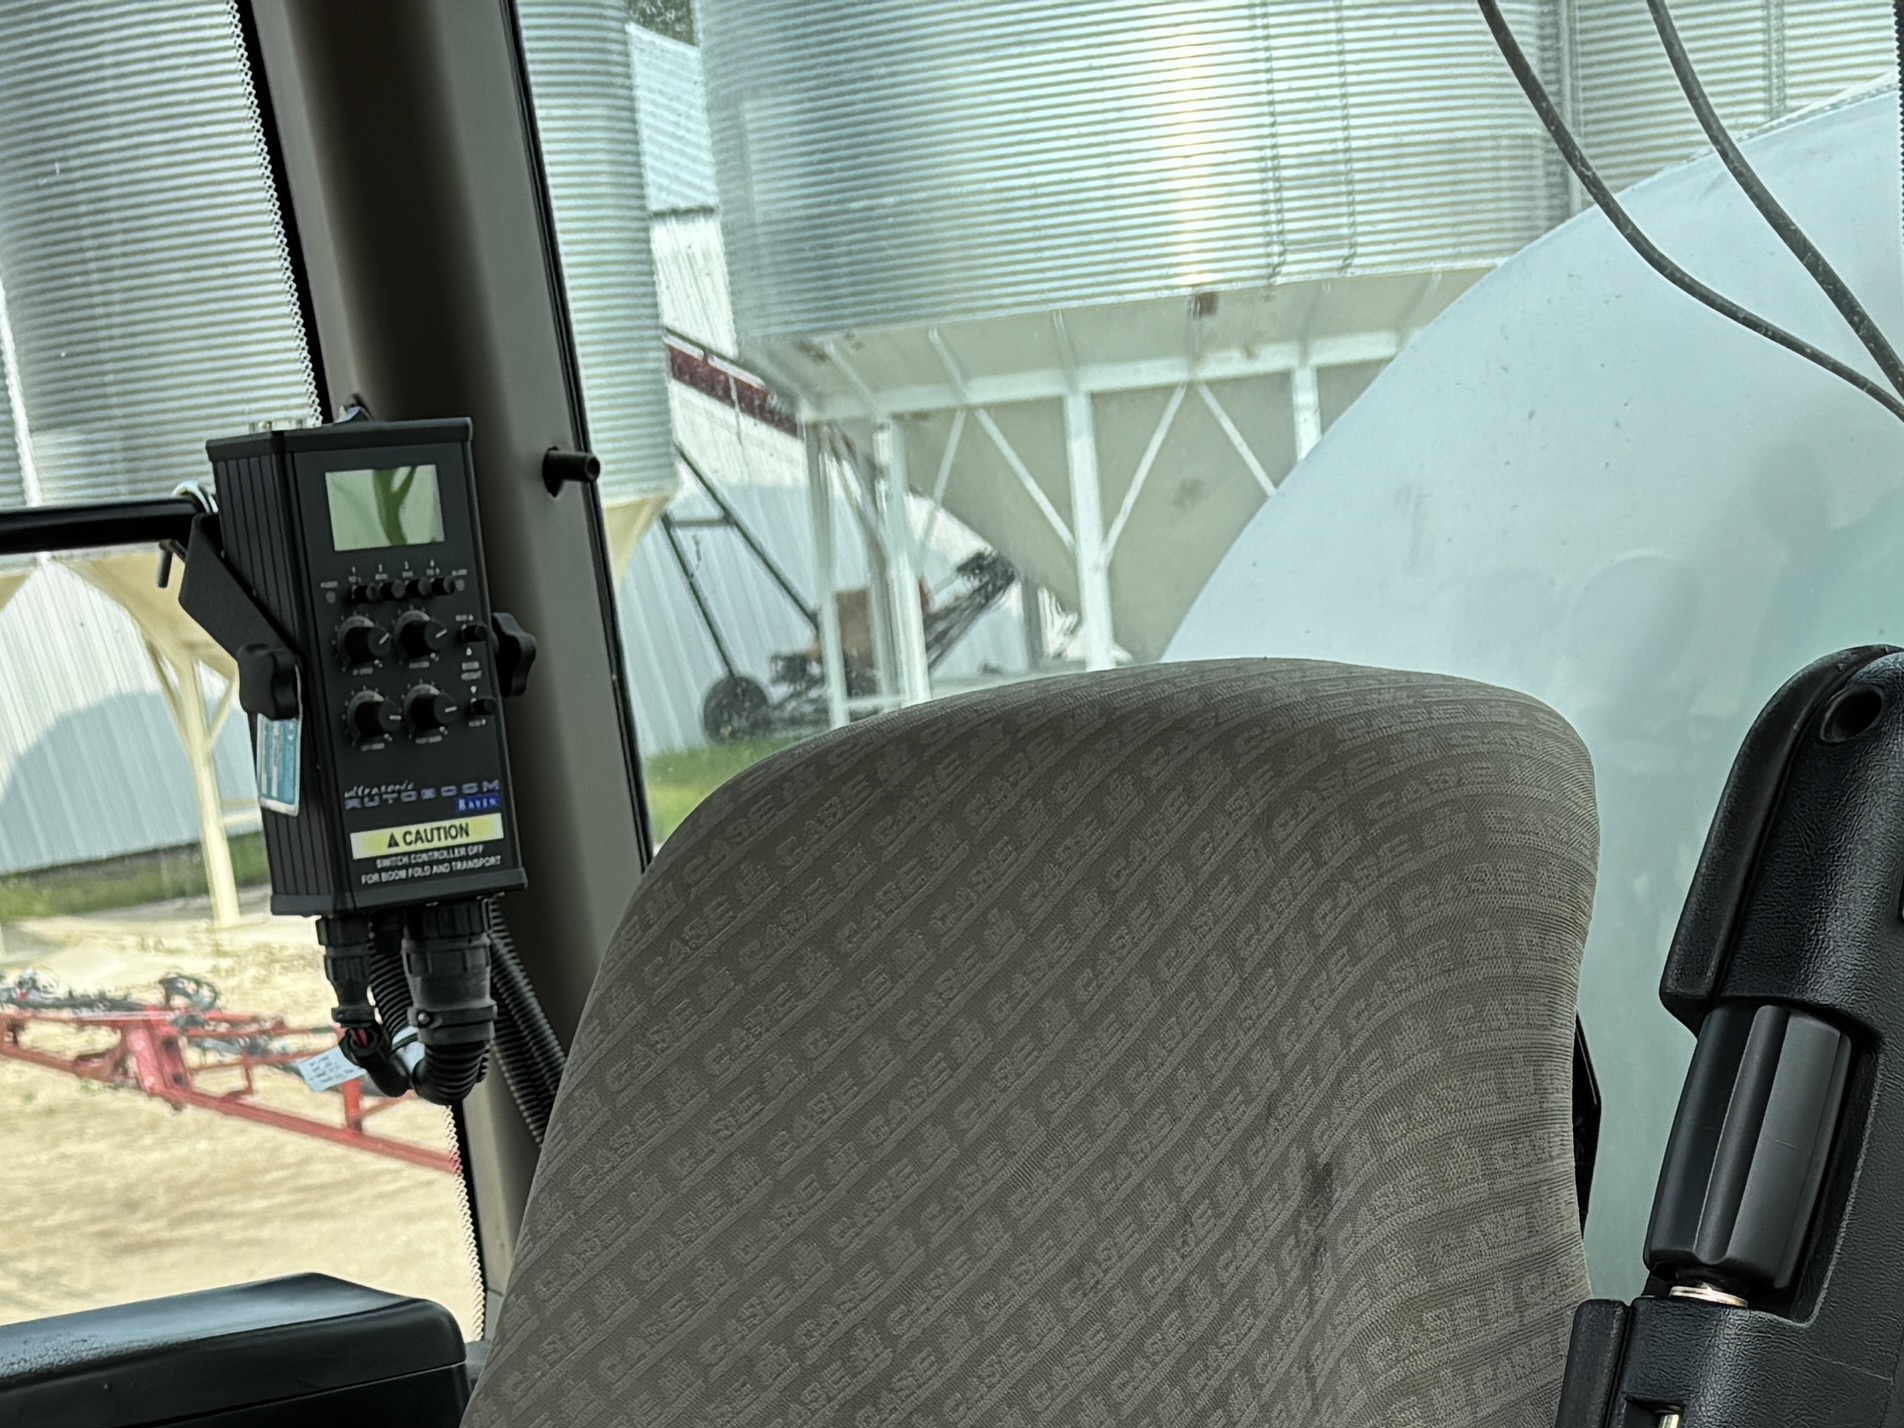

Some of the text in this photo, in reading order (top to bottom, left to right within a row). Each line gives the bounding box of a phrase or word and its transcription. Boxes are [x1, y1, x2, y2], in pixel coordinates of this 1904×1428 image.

[402, 822, 470, 846] CAUTION
[410, 846, 467, 865] CONTROLLER
[361, 872, 381, 885] FOR
[432, 863, 451, 875] AND
[451, 855, 502, 871] TRANSPORT
